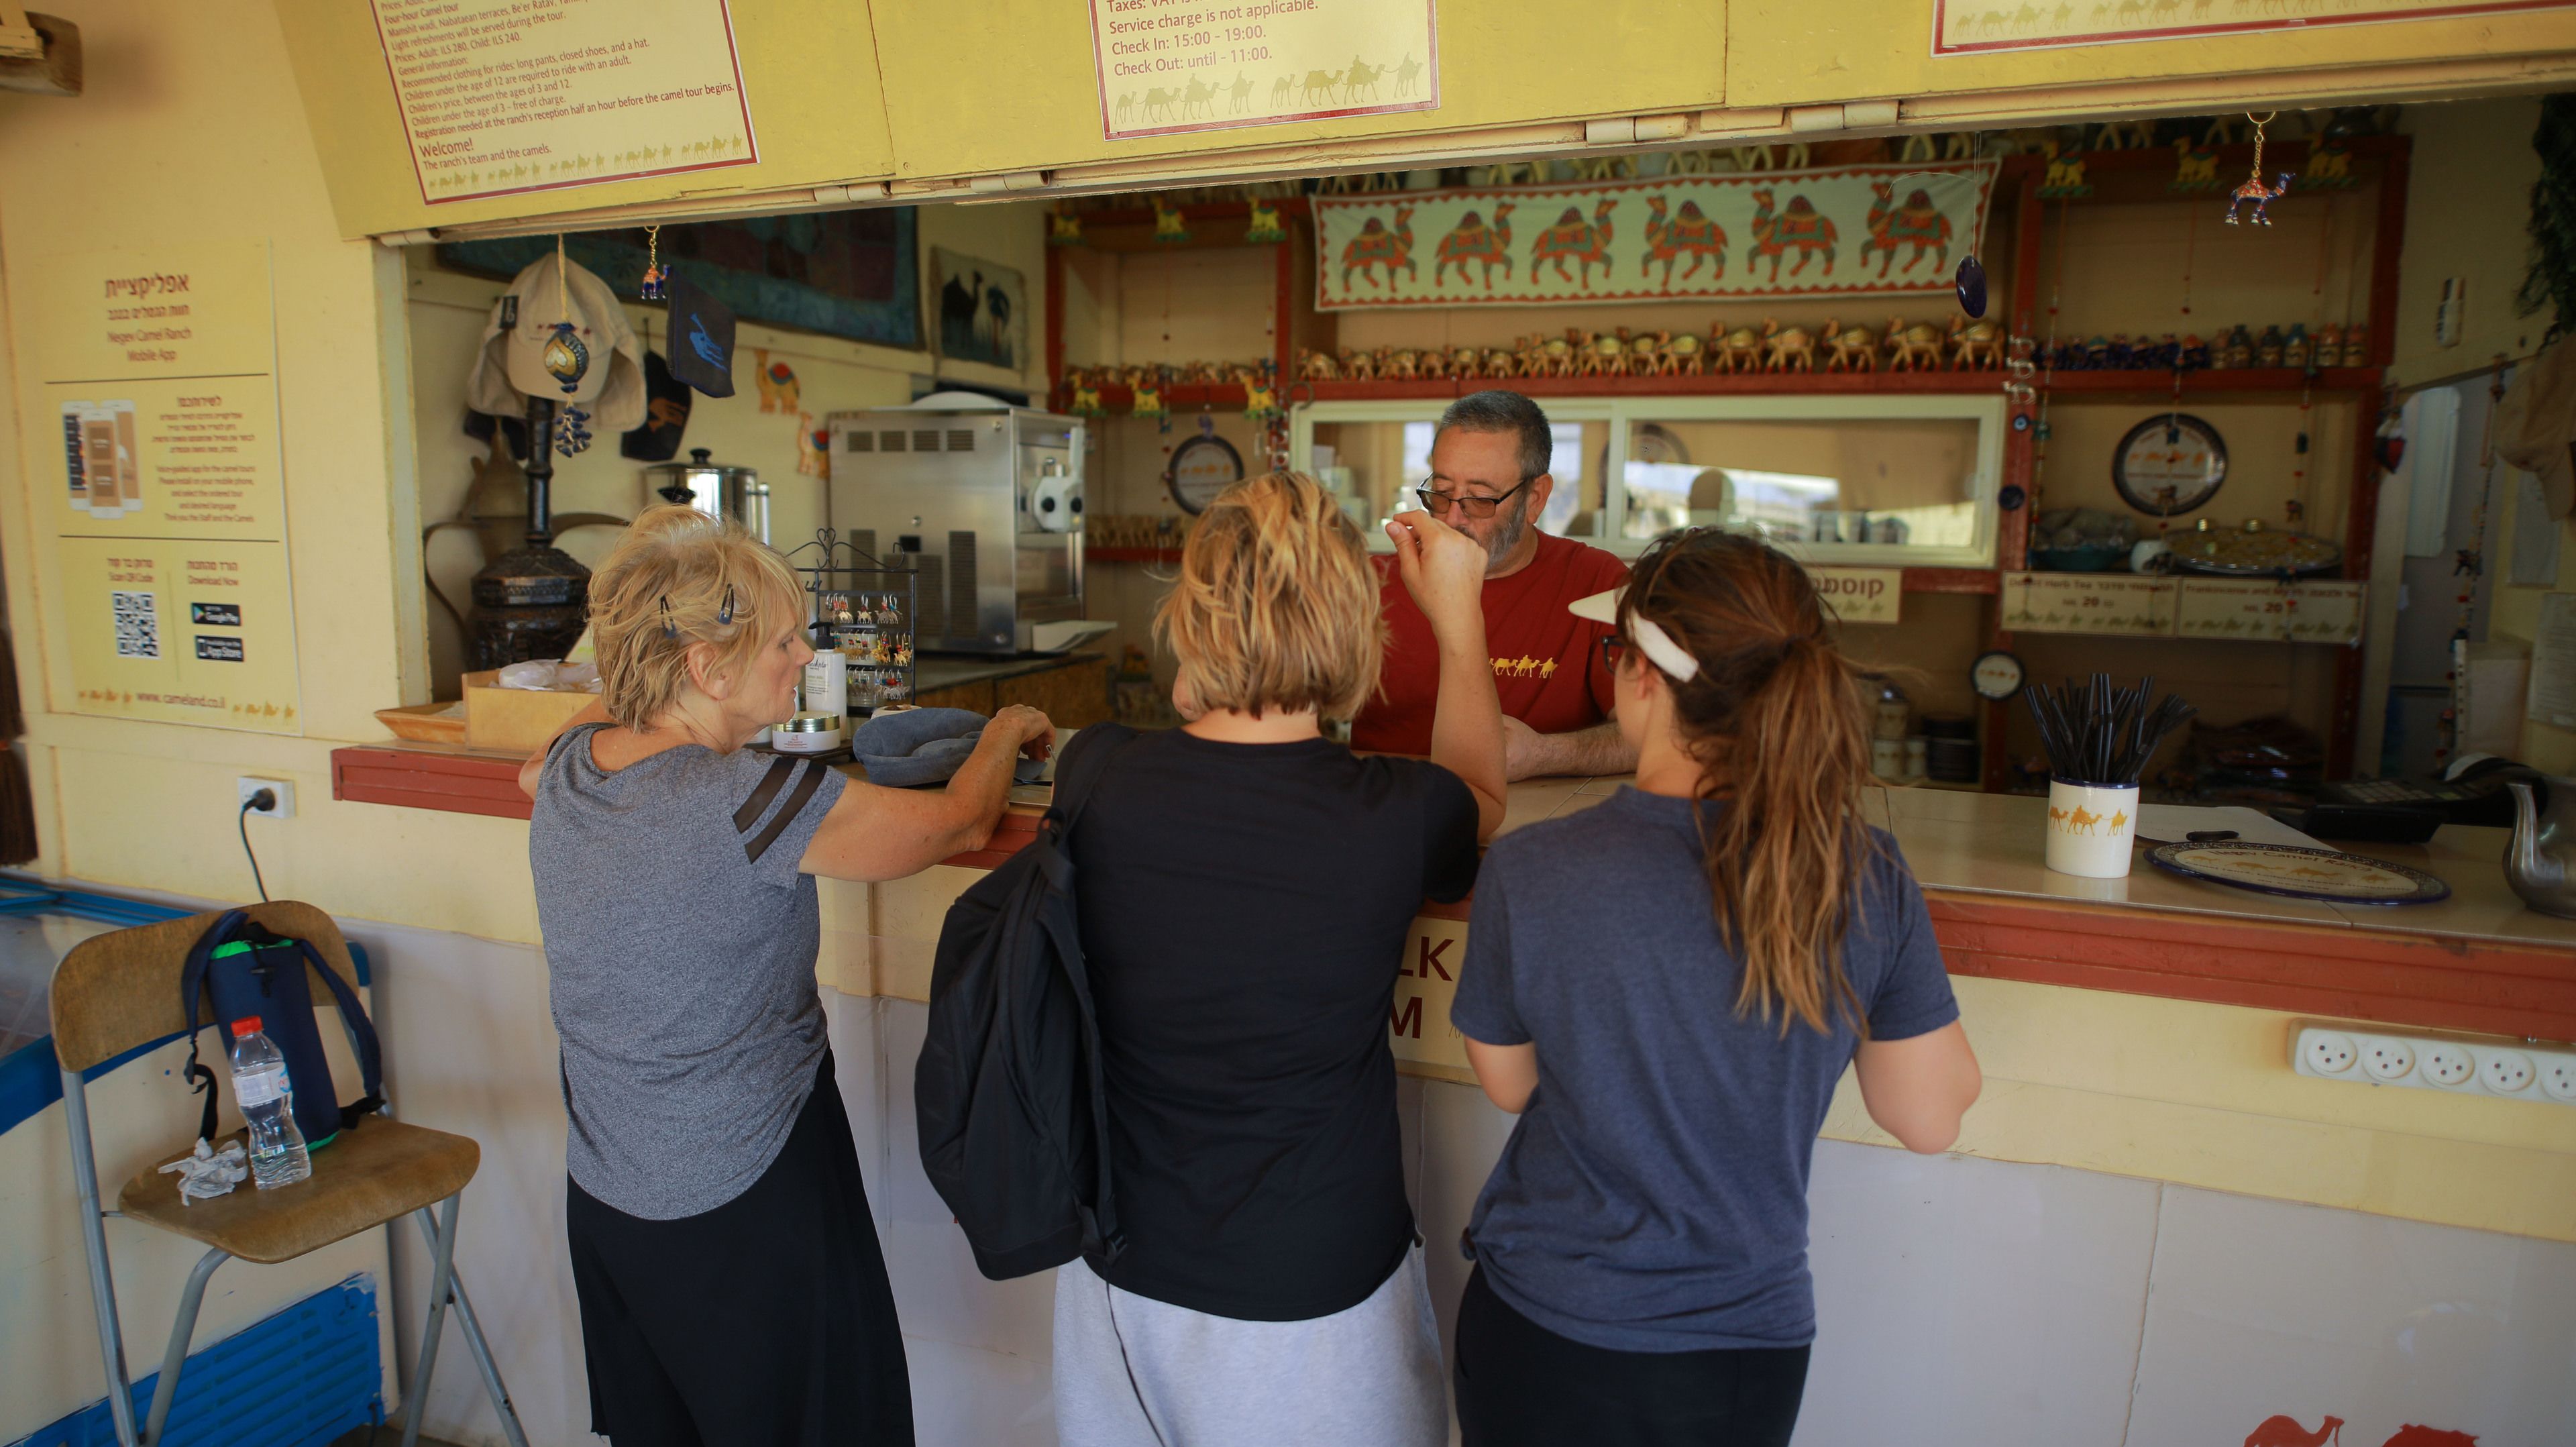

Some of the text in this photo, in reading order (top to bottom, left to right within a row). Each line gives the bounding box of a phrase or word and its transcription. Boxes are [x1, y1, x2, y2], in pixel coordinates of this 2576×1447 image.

[420, 5, 443, 17] Camel
[443, 3, 459, 13] tour
[439, 13, 478, 27] Nabataean
[511, 3, 531, 13] Be'er
[1106, 0, 1146, 13] Taxes:
[1109, 0, 1318, 34] Service charge is not applicable.
[391, 11, 566, 52] Light refreshments will be served during the tour.
[440, 44, 451, 54] ILS
[470, 37, 491, 50] Child:
[492, 35, 504, 46] ILS
[505, 32, 522, 43] 240.
[1112, 38, 1150, 55] Check
[1154, 38, 1169, 50] In:
[1174, 31, 1211, 48] 15:00
[1225, 25, 1267, 42] 19:00.
[398, 56, 468, 76] General information:
[401, 38, 650, 88] Recommended clothing for rides: long pants, closed shoes, and a hat.
[1114, 59, 1152, 76] Check
[1156, 58, 1183, 71] Out:
[1187, 51, 1216, 68] until
[1230, 46, 1273, 63] 11:00.
[405, 54, 631, 101] Children under the age of 12 are required to ride with an adult.
[408, 101, 442, 114] Children's
[464, 93, 494, 105] between
[496, 89, 508, 99] the
[510, 88, 526, 99] ages
[527, 85, 535, 94] of
[537, 84, 542, 93] 3
[544, 81, 558, 92] and
[560, 79, 572, 89] 12.
[412, 114, 440, 126] Children
[441, 111, 462, 121] under
[463, 109, 475, 118] the
[477, 107, 490, 117] age
[491, 104, 499, 113] of
[500, 103, 505, 112] 3
[513, 101, 528, 110] free
[529, 97, 537, 107] of
[539, 95, 566, 107] charge.
[415, 82, 735, 140] Registration needed at the ranch's reception half an hour before the camel tour begins.
[419, 138, 474, 158] Welcome!
[423, 143, 552, 170] The ranch's team and the camels.
[105, 272, 189, 299] אפליקציית
[107, 326, 191, 345] Negev Camel Ranch
[127, 348, 176, 362] Mobile App
[189, 575, 222, 586] Download
[205, 611, 239, 623] Google Play
[207, 646, 241, 658] App Store
[2263, 851, 2318, 861] Camel
